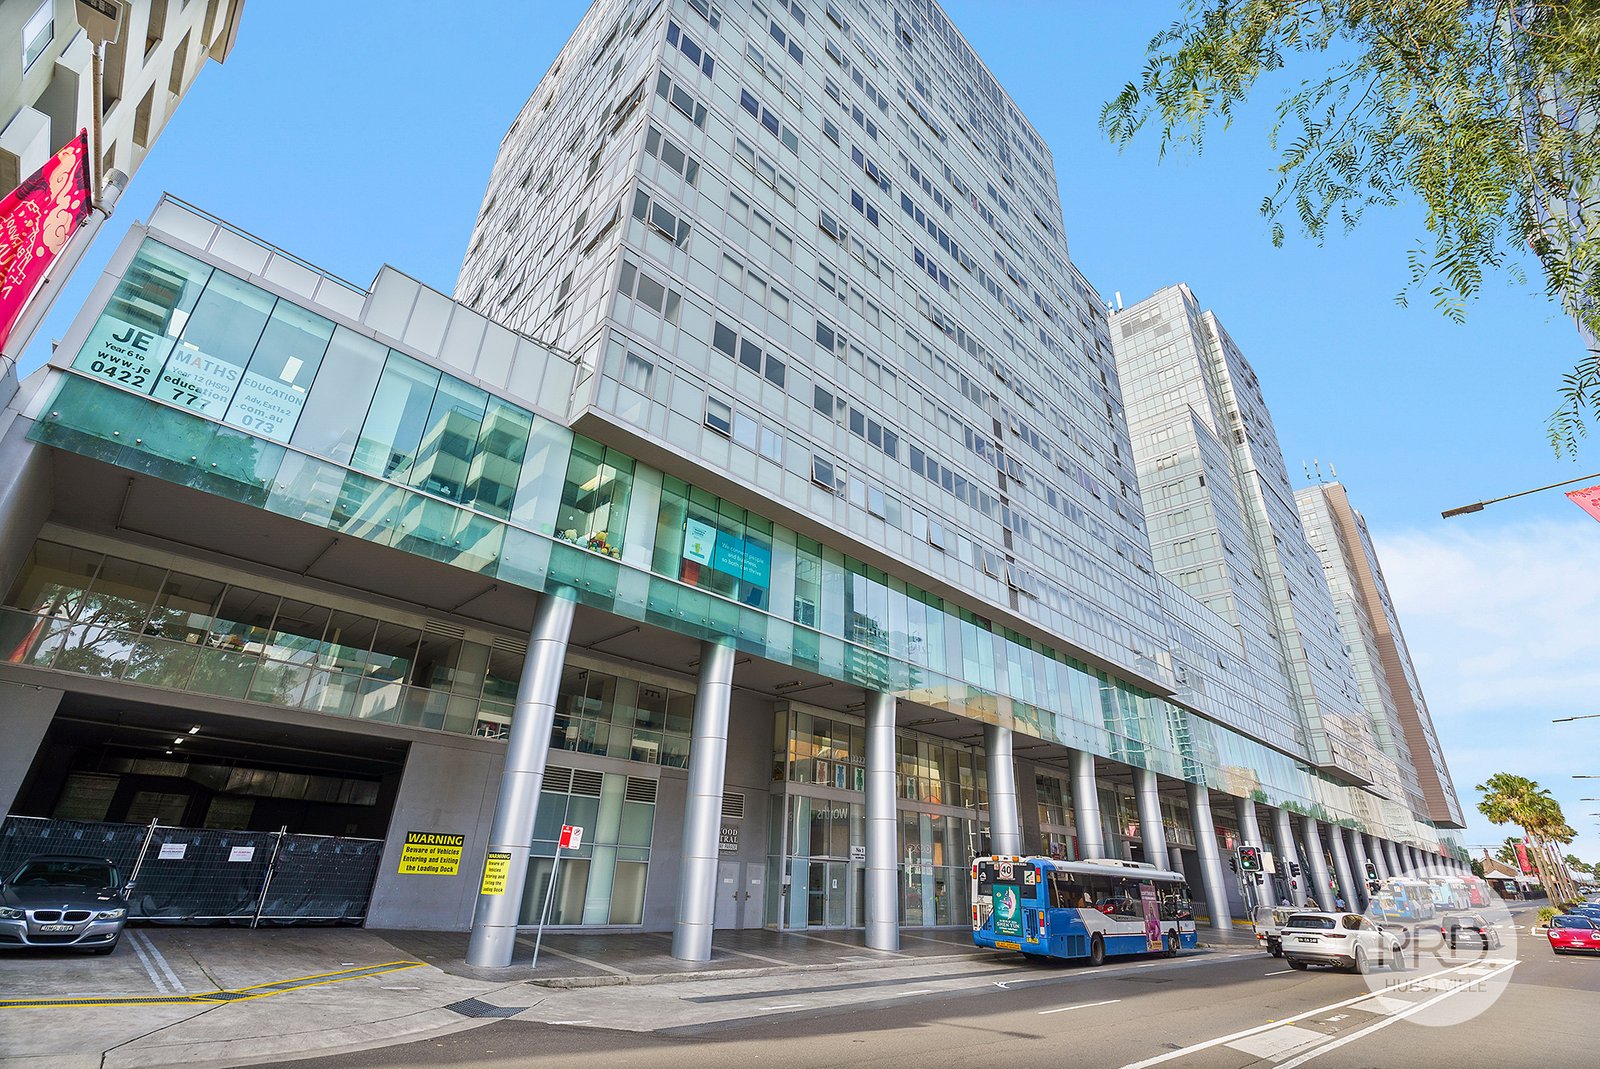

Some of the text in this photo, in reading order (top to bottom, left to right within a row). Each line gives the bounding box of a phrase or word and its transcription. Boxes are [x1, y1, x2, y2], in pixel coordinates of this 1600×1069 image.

[105, 341, 126, 354] Year
[135, 353, 145, 361] to
[172, 366, 192, 378] Year
[194, 374, 204, 382] 12
[205, 379, 230, 394] (HSC)
[112, 327, 303, 406] JE MATHS EDUCATION
[163, 375, 228, 403] education
[90, 360, 275, 434] 0422 777 073
[721, 541, 730, 549] We
[727, 559, 739, 567] both
[408, 833, 463, 846] WARNING
[405, 846, 428, 854] Beware
[437, 847, 460, 855] Vehicles
[402, 855, 427, 863] Entering
[440, 857, 459, 865] Exiting
[416, 865, 439, 873] Loading
[439, 865, 454, 873] Dock
[1001, 865, 1012, 875] 40
